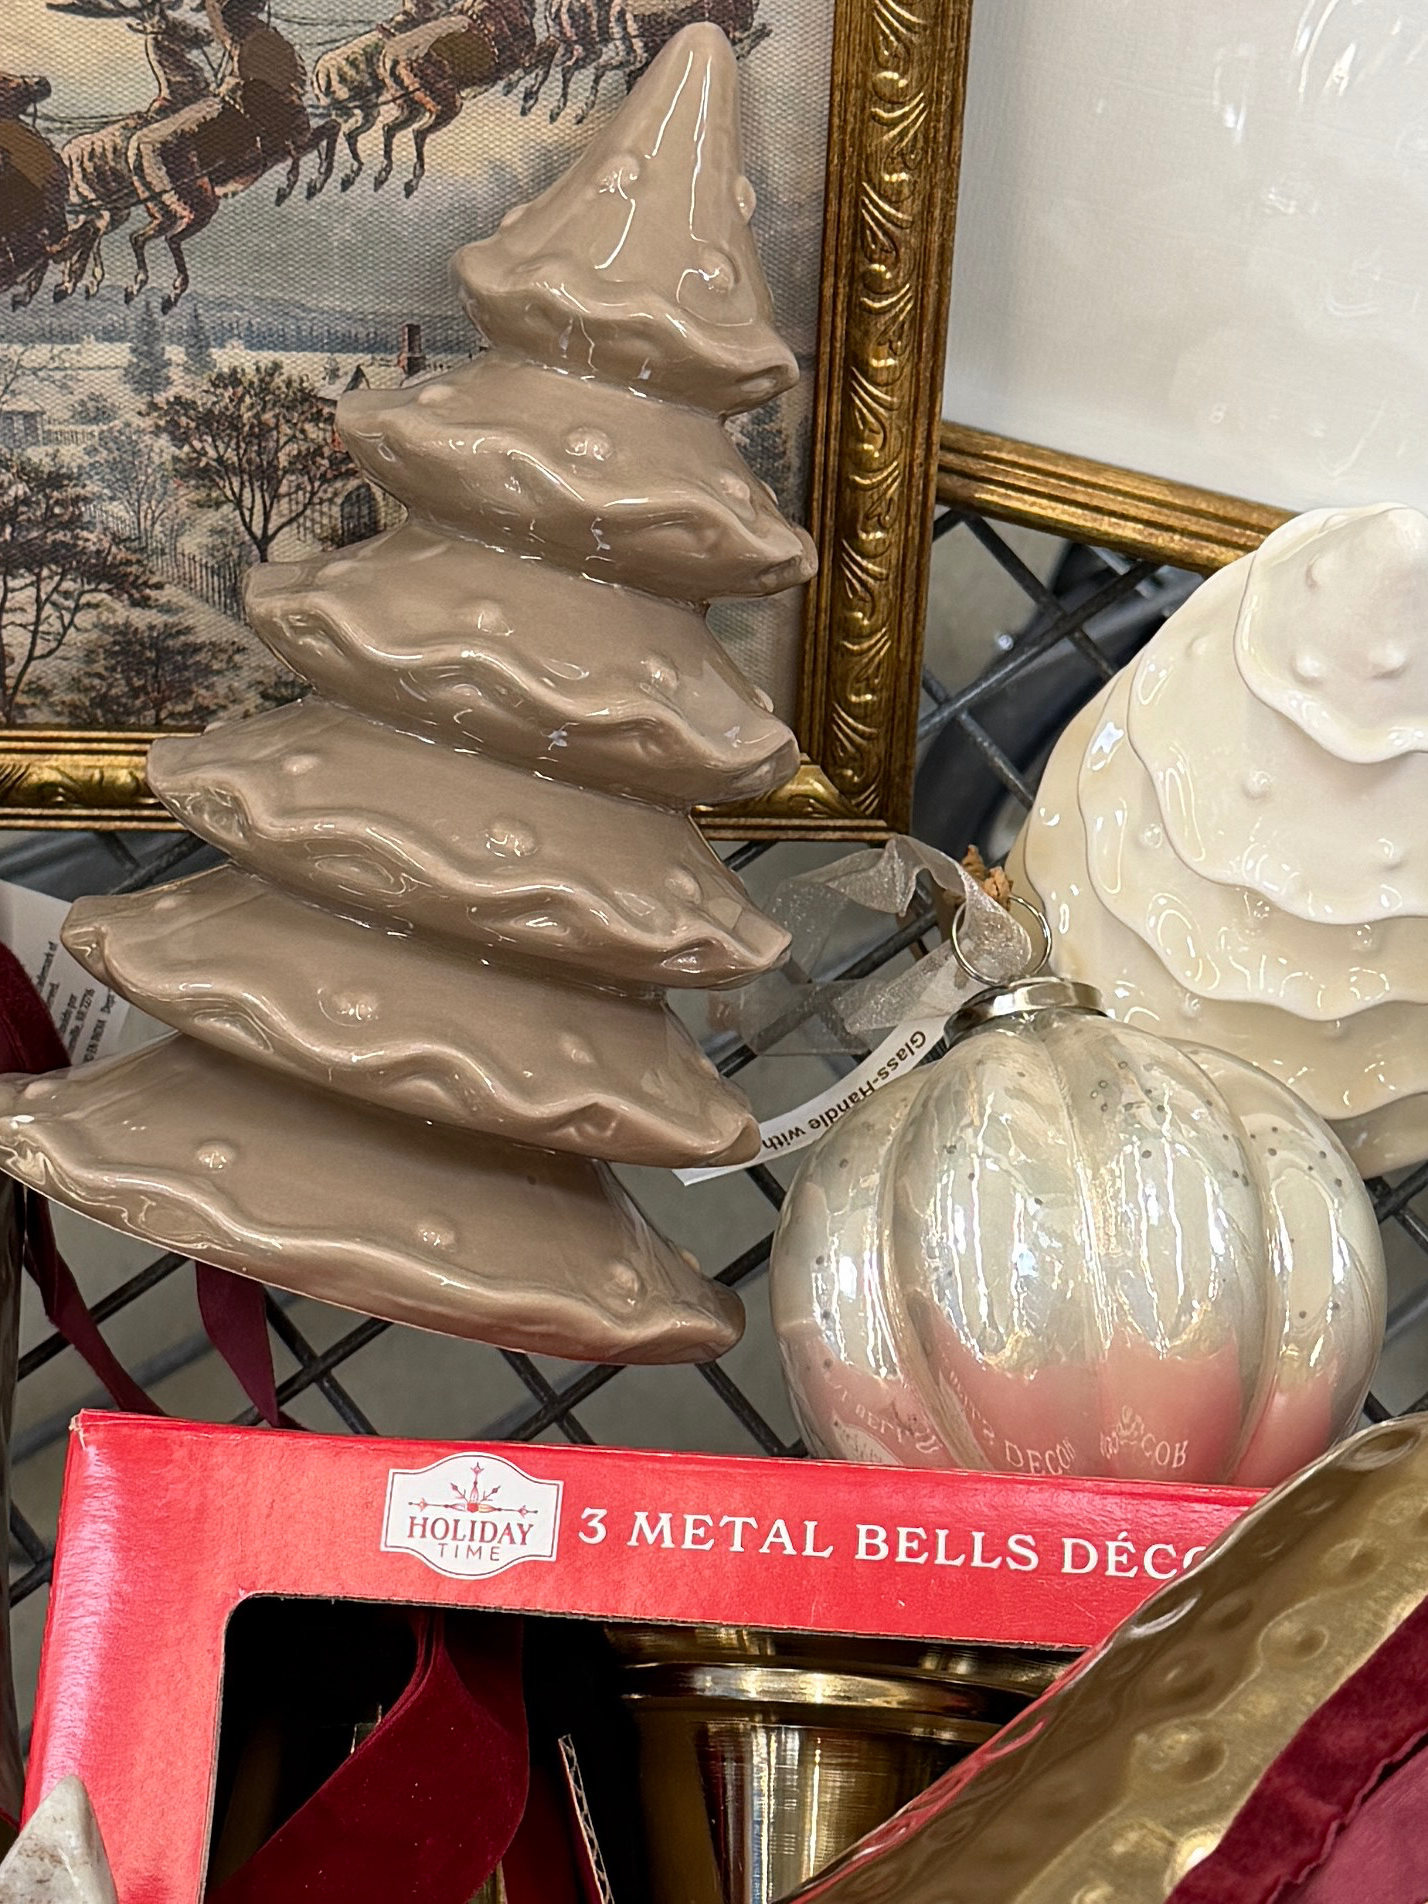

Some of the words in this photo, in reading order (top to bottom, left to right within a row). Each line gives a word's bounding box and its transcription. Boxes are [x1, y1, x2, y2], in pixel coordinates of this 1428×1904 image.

[808, 1031, 926, 1129] Glass-Handle
[762, 1126, 806, 1150] with
[407, 1516, 534, 1546] HOLIDAY
[578, 1507, 608, 1544] 3
[626, 1511, 834, 1558] METAL
[855, 1524, 1040, 1572] BELLS
[438, 1543, 501, 1561] TIME
